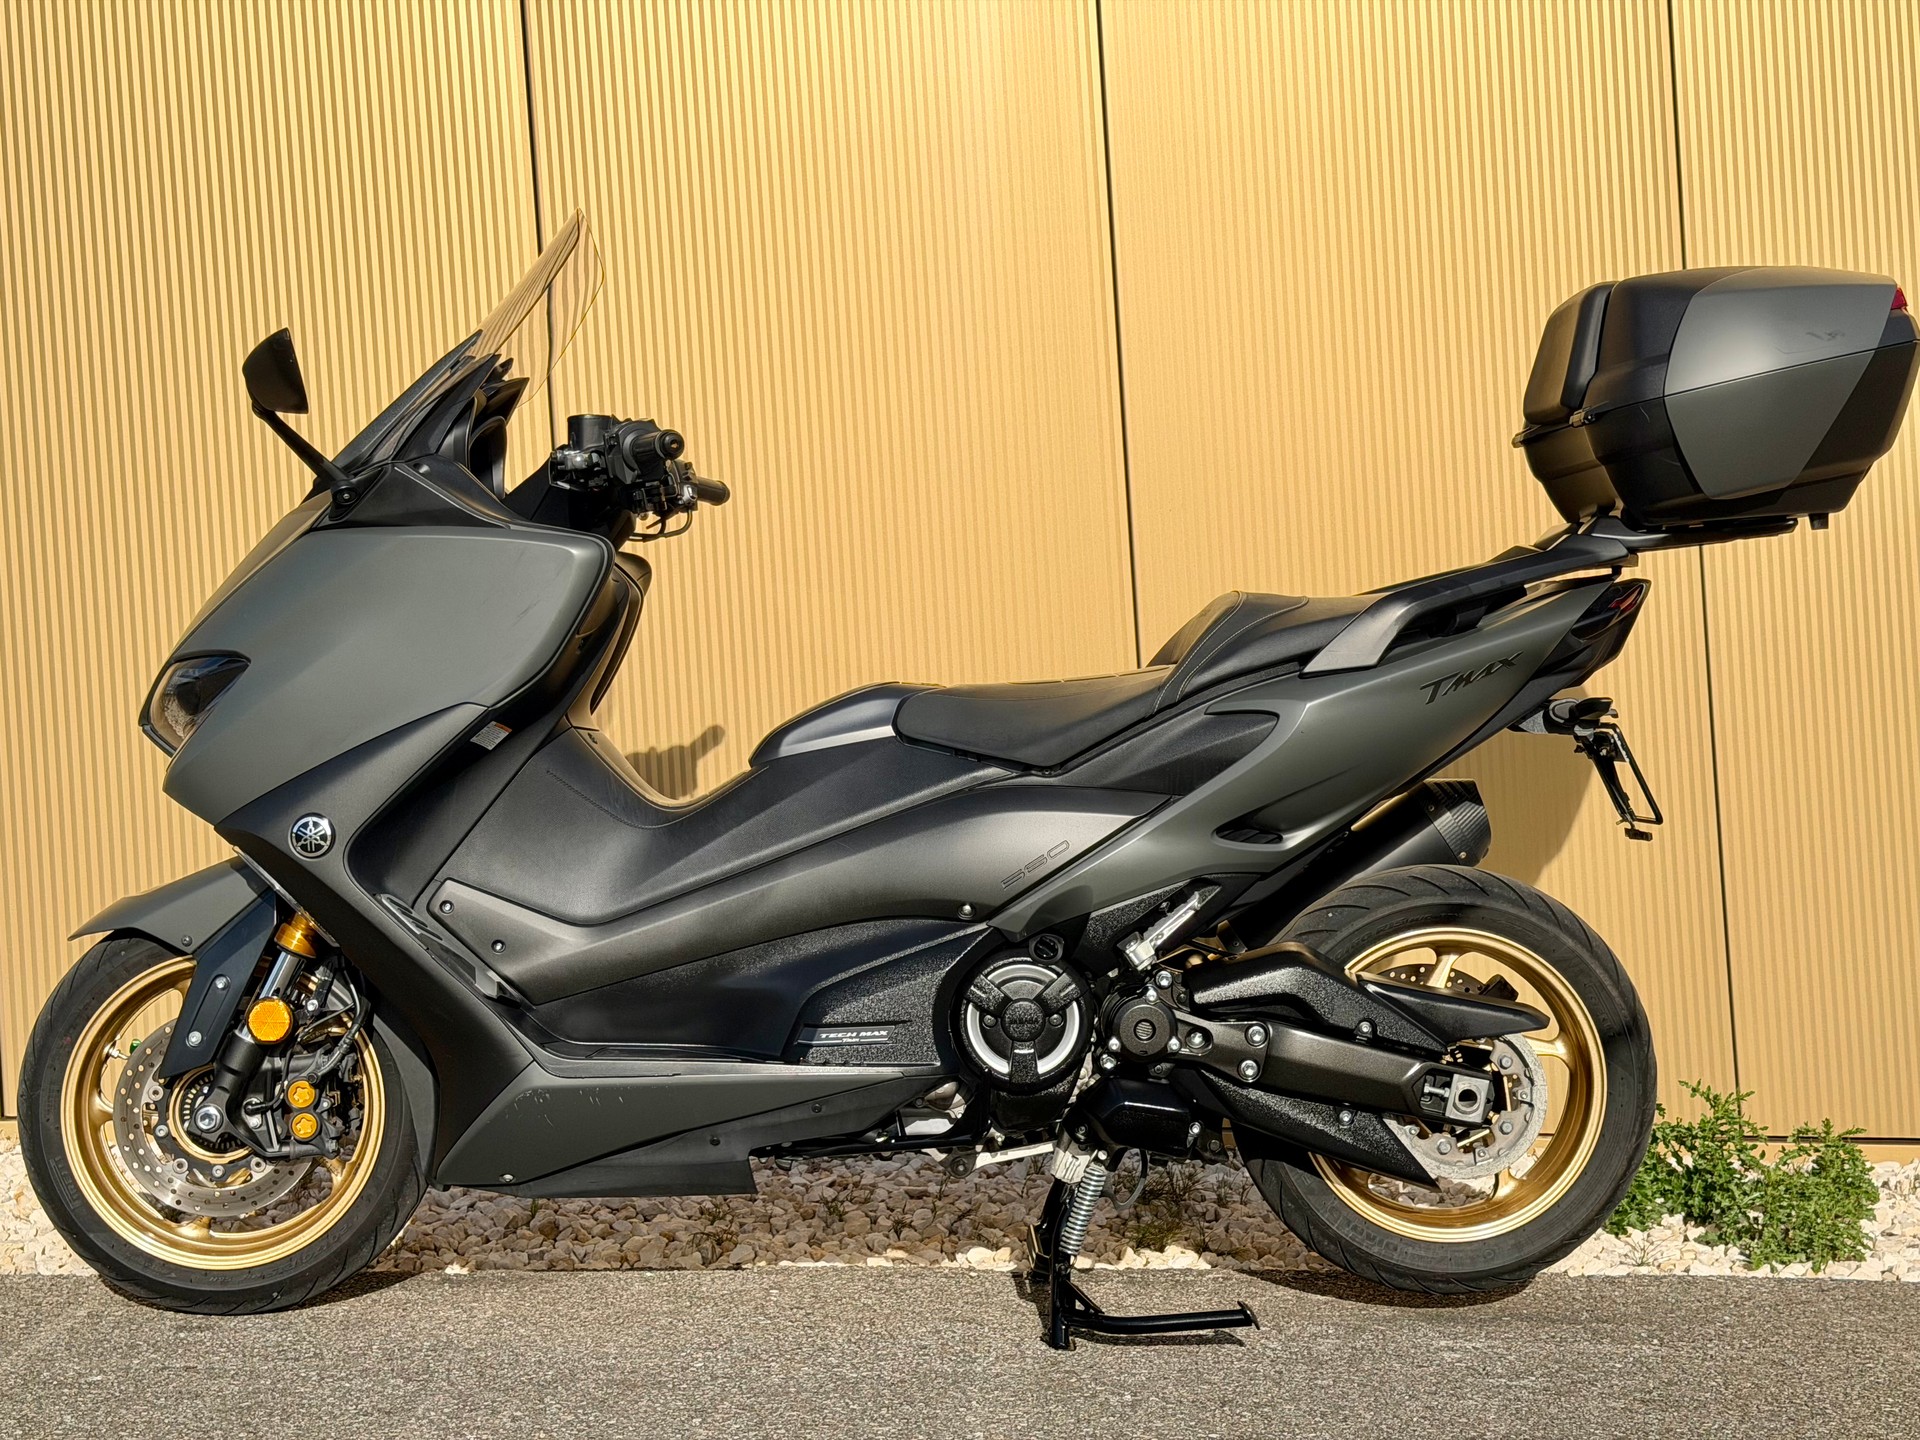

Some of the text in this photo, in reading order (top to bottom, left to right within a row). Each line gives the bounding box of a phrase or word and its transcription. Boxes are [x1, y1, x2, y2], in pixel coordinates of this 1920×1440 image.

[1419, 650, 1524, 705] TMAX
[819, 1029, 889, 1039] TECH MAX
